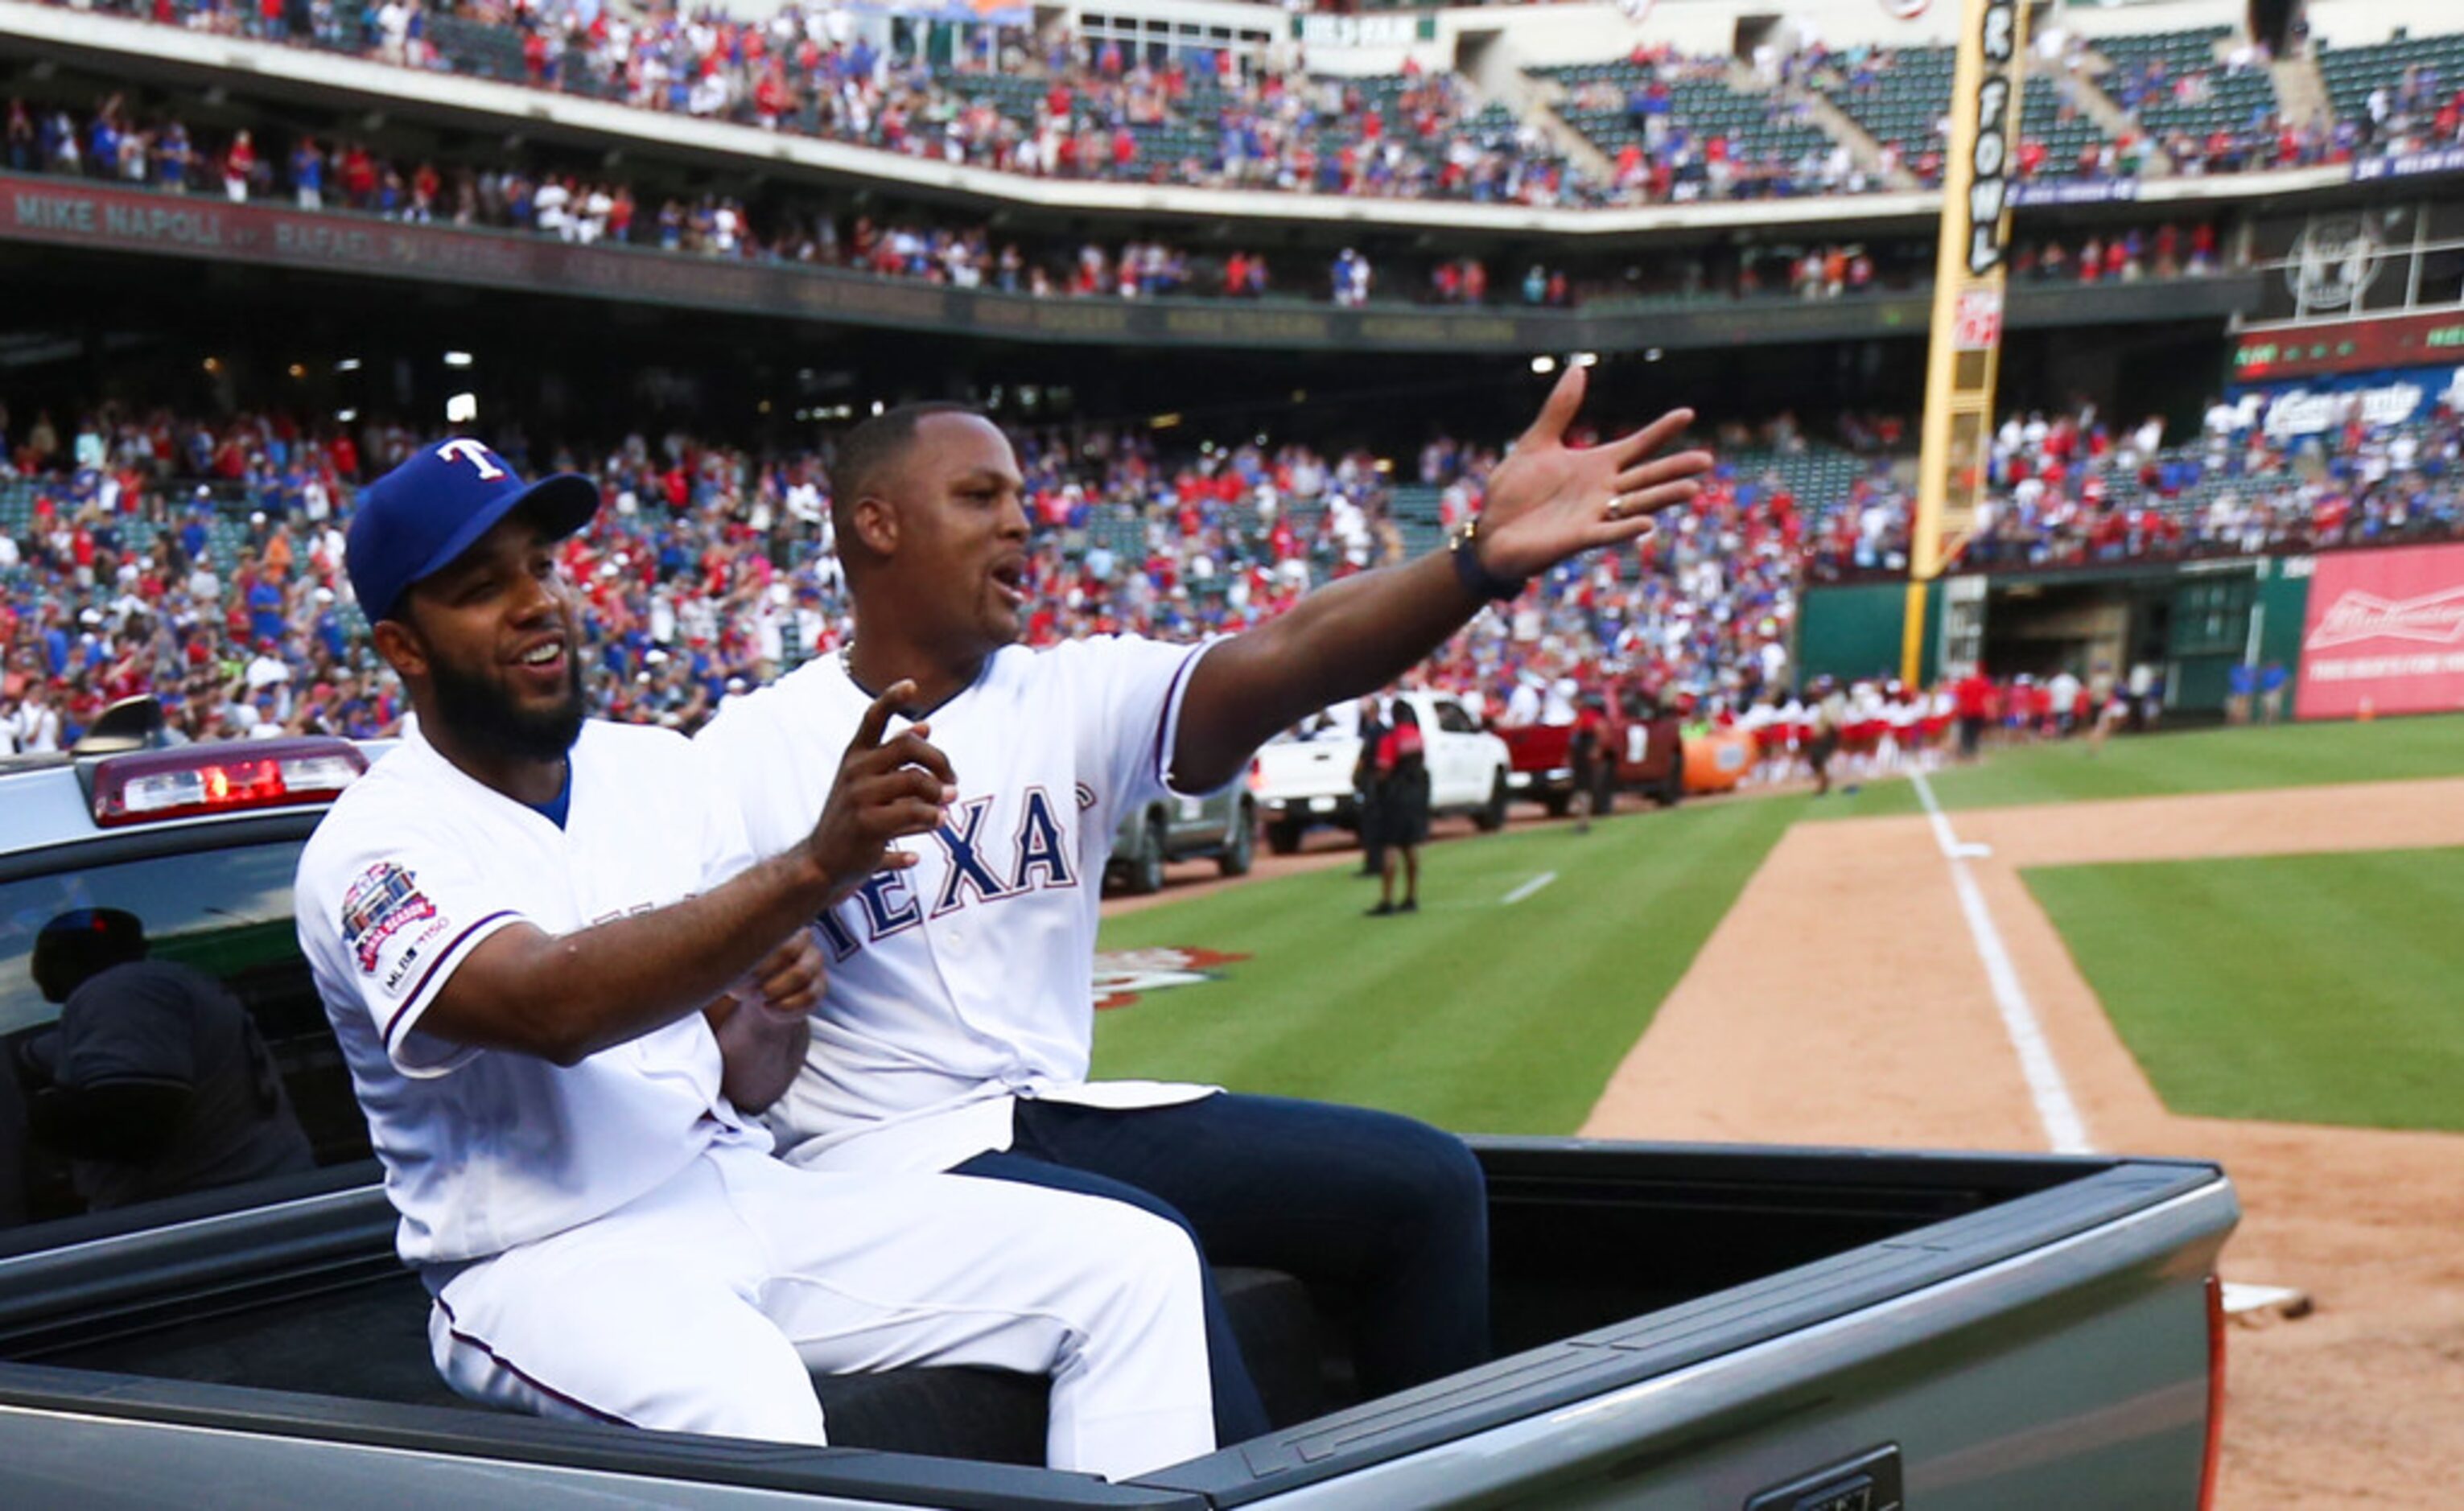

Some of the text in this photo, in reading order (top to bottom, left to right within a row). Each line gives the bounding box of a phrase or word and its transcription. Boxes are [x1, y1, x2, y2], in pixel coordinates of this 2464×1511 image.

[1969, 78, 2012, 274] FOWL
[14, 194, 95, 232] MIKE
[105, 204, 220, 247] NAPOLI
[436, 438, 508, 480] T
